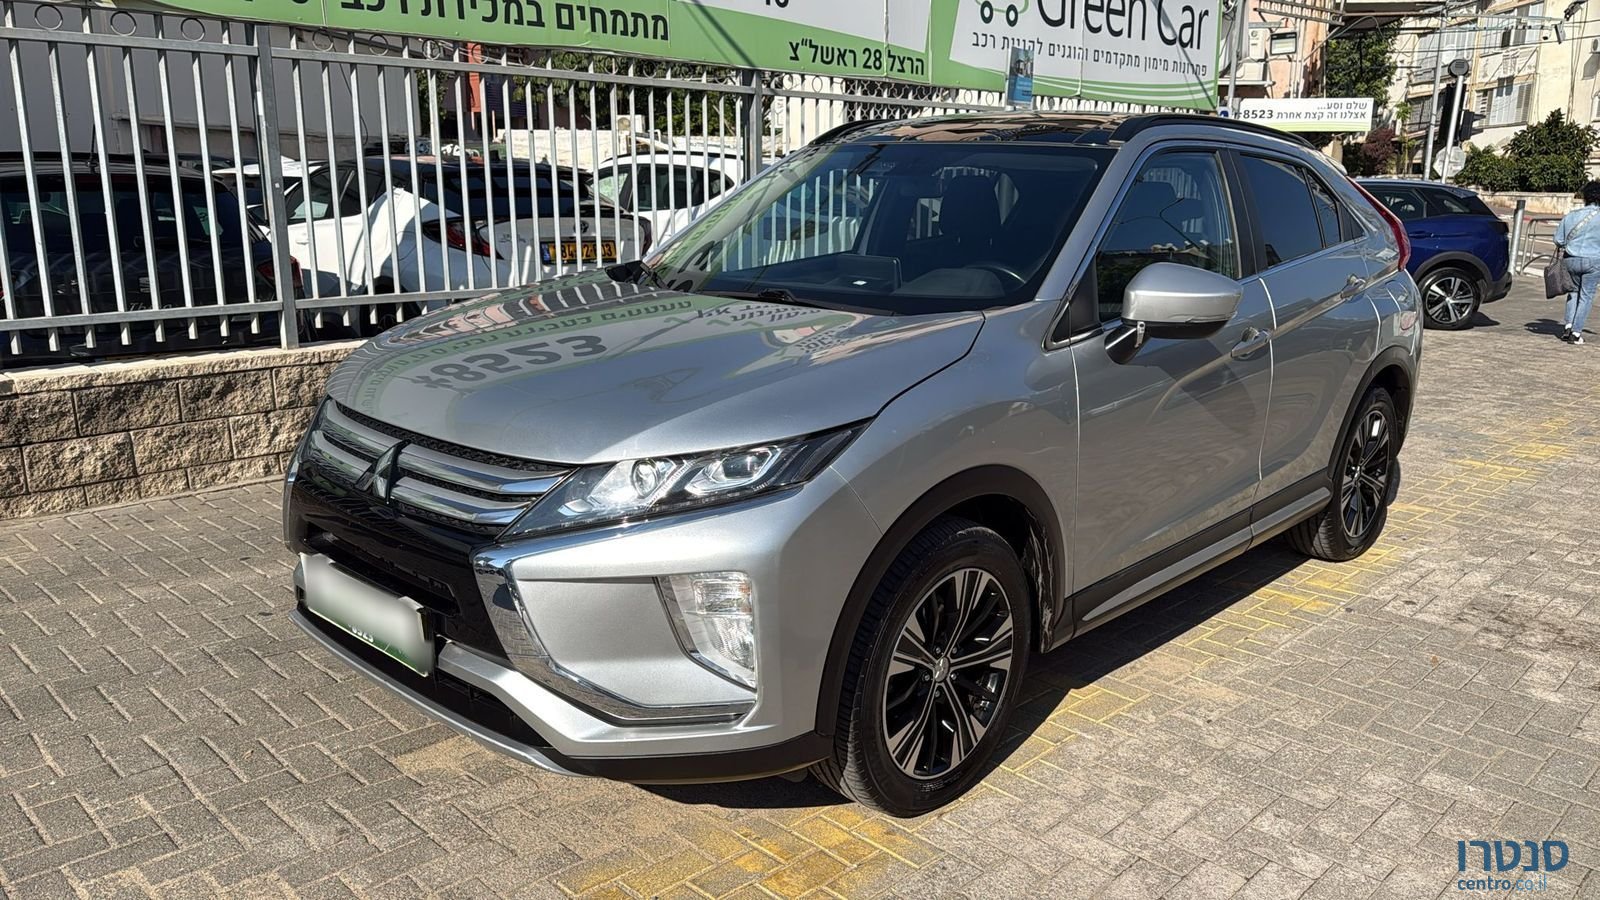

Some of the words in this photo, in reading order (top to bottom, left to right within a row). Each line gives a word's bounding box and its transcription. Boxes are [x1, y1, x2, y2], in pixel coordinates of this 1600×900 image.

[555, 3, 669, 41] מתמחים
[1157, 0, 1210, 51] Car
[972, 31, 996, 49] רכב
[862, 47, 883, 70] 28
[887, 49, 924, 75] הרצל
[1093, 49, 1141, 69] מתקדמים
[1144, 56, 1169, 73] מימון
[1345, 100, 1368, 110] שלם
[1276, 111, 1302, 119] אחרת
[1304, 111, 1324, 120] קצת
[1326, 111, 1338, 119] זה
[1340, 110, 1367, 119] אצלנו
